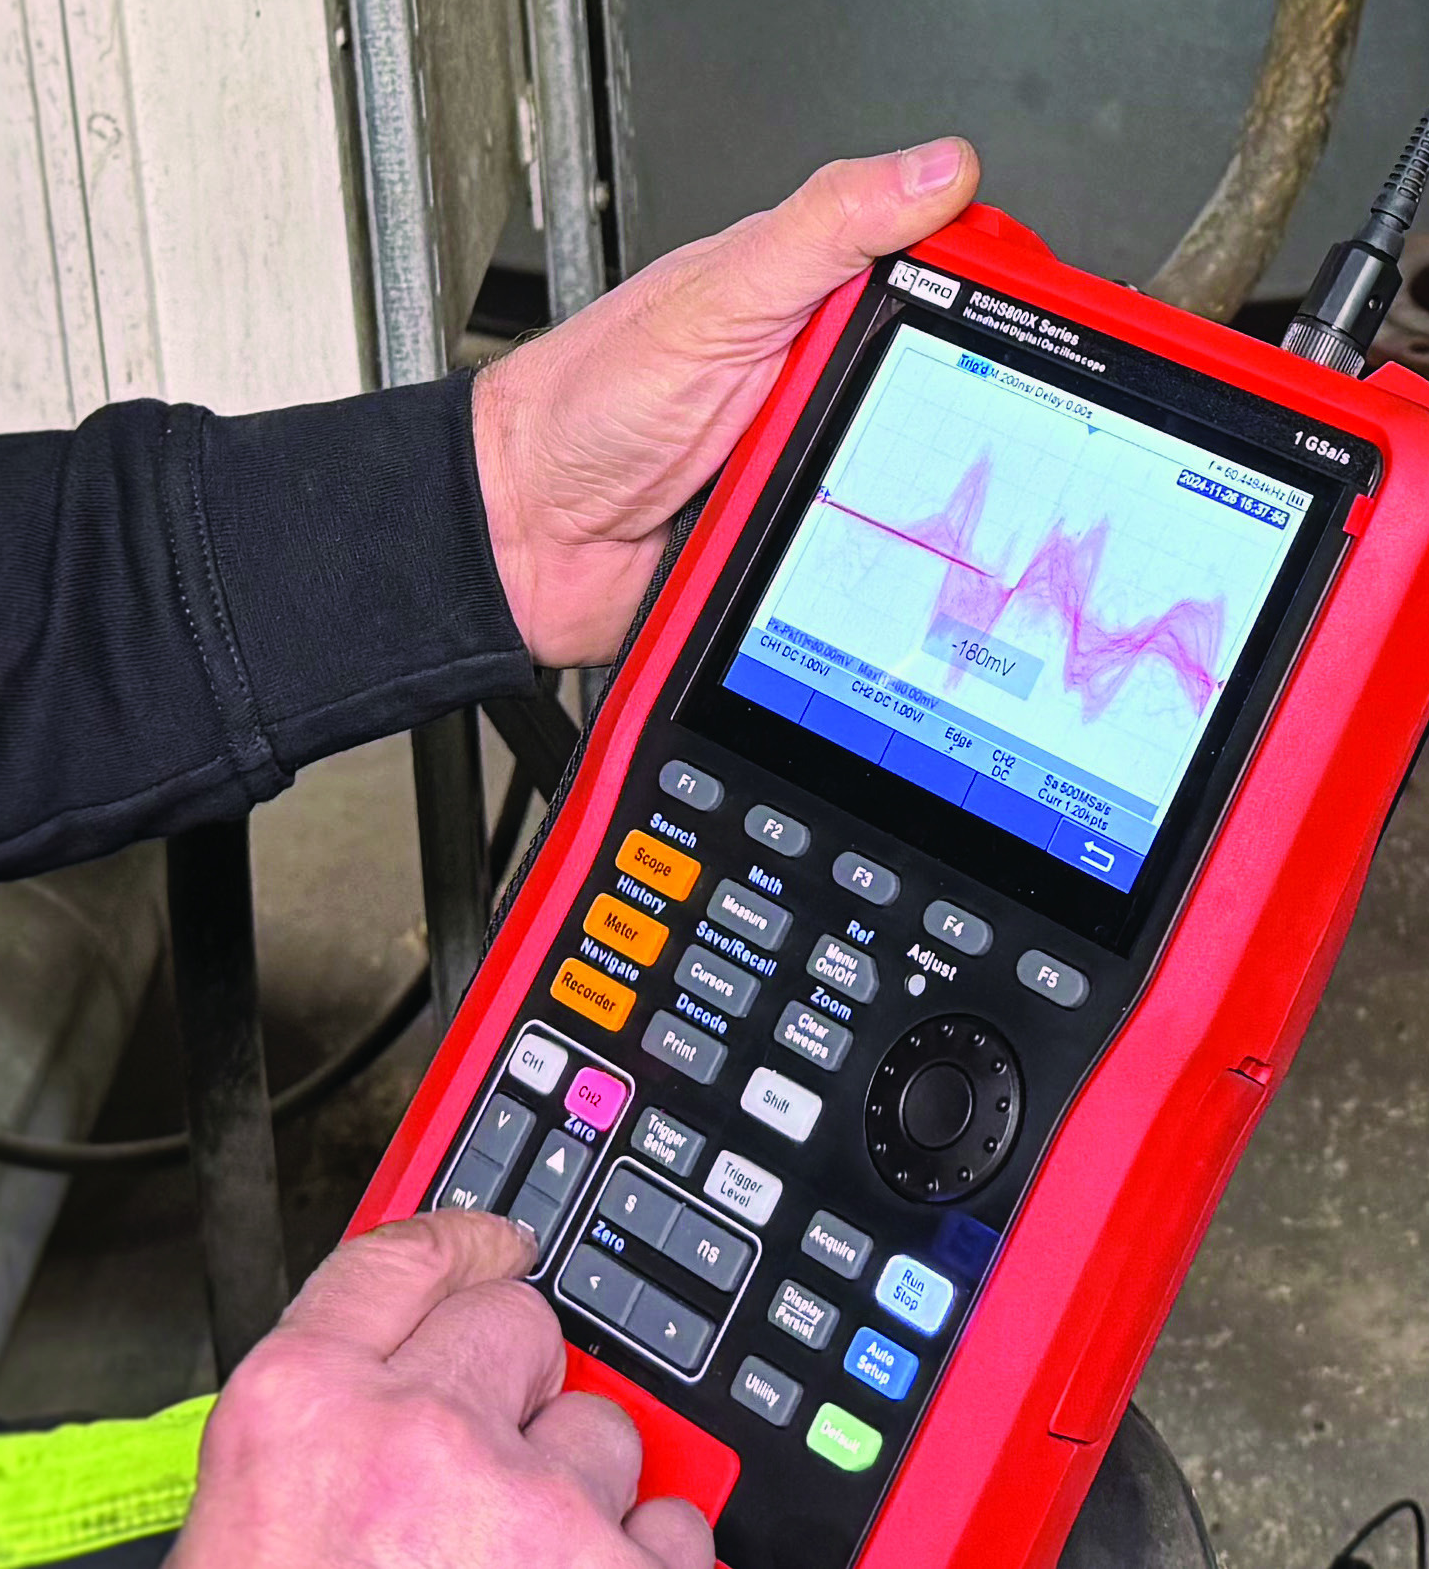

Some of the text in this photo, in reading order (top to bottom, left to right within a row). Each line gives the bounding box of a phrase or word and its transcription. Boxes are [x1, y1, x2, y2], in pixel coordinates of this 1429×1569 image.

[918, 278, 953, 299] PRO
[970, 291, 1080, 346] RSHS800X Series
[962, 306, 1107, 373] Handheld Digital Oscilloscope
[1034, 386, 1065, 409] Delay
[1294, 431, 1351, 466] 1 GSa/s
[760, 635, 781, 652] CH1
[782, 646, 799, 661] DC
[951, 639, 1016, 676] -180mV
[852, 681, 874, 698] CH2
[874, 691, 891, 707] DC
[945, 727, 972, 748] Edge
[992, 750, 1016, 768] CH2
[992, 766, 1010, 781] DC
[677, 773, 697, 794] F1
[1044, 774, 1059, 789] Sa
[1038, 788, 1062, 807] Curr
[650, 813, 697, 848] Search
[763, 819, 783, 839] F2
[634, 847, 672, 877] Scope
[748, 865, 783, 895] Math
[852, 867, 873, 888] F3
[616, 874, 666, 914] History
[604, 912, 639, 941] Meter
[722, 894, 768, 930] Measure
[942, 915, 964, 937] F4
[847, 920, 875, 944] Ref
[580, 937, 640, 981] Navigate
[696, 921, 777, 977] Save/Recall
[825, 943, 858, 969] Menu
[906, 943, 957, 981] Adjust
[690, 962, 734, 997] Cursors
[815, 958, 858, 988] On/Off
[1037, 965, 1060, 988] F5
[561, 971, 617, 1012] Recorder
[810, 986, 853, 1021] Zoom
[676, 993, 727, 1034] Decode
[798, 1013, 830, 1039] Clear
[663, 1031, 697, 1062] Print
[784, 1024, 829, 1059] Sweeps
[522, 1050, 545, 1073] CH1
[578, 1085, 602, 1108] CH2
[763, 1089, 790, 1114] Shift
[498, 1110, 511, 1130] V
[564, 1113, 596, 1143] Zero
[647, 1113, 688, 1148] Trigger
[643, 1132, 677, 1165] Setup
[722, 1161, 763, 1193] Trigger
[452, 1187, 478, 1210] mV
[720, 1181, 751, 1208] Level
[591, 1220, 626, 1253] Zero
[696, 1238, 720, 1265] ns
[809, 1225, 856, 1263] Acquire
[901, 1268, 925, 1293] Run
[783, 1285, 824, 1324] Display
[893, 1286, 919, 1311] Stop
[775, 1306, 815, 1340] Persist
[866, 1341, 895, 1366] Auto
[856, 1354, 891, 1386] Setup
[744, 1372, 780, 1408] Utility
[820, 1419, 861, 1455] Default
